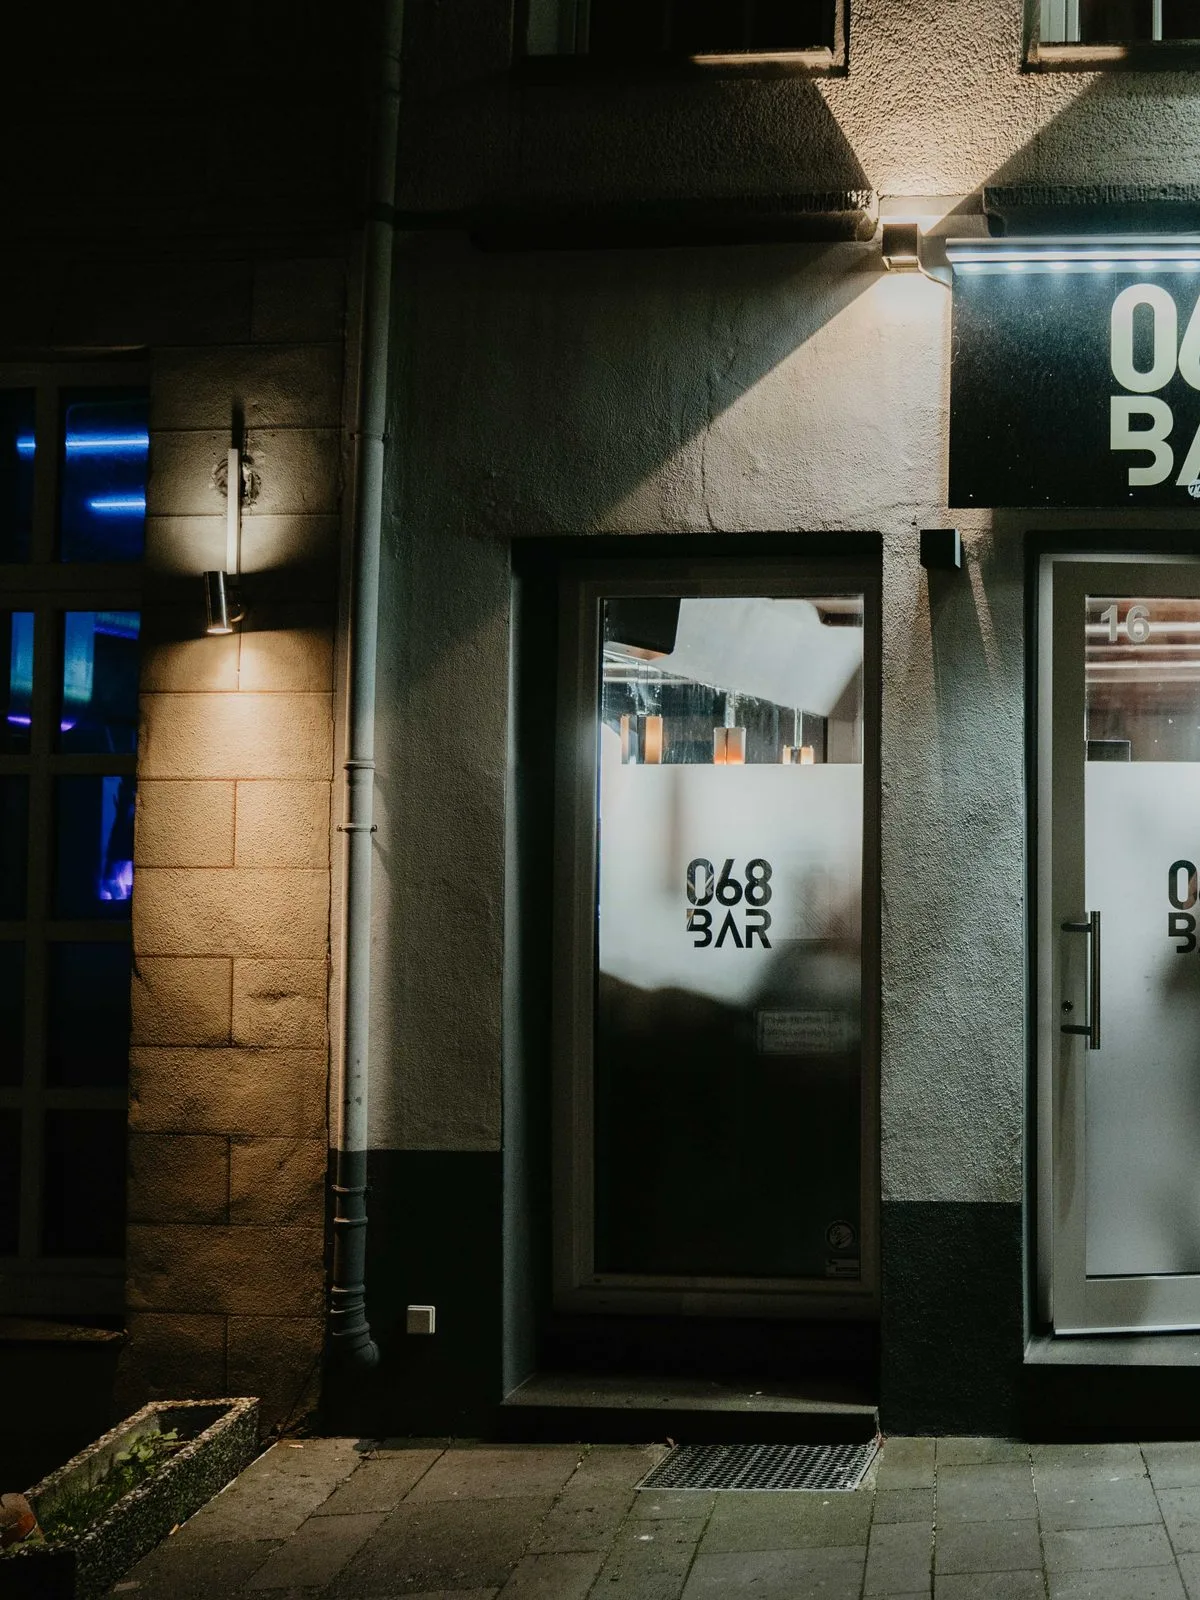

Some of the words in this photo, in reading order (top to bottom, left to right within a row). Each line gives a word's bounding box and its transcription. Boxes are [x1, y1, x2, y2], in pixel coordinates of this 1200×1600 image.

[1100, 604, 1151, 643] 16
[686, 858, 772, 907] 068
[686, 908, 772, 949] BAR
